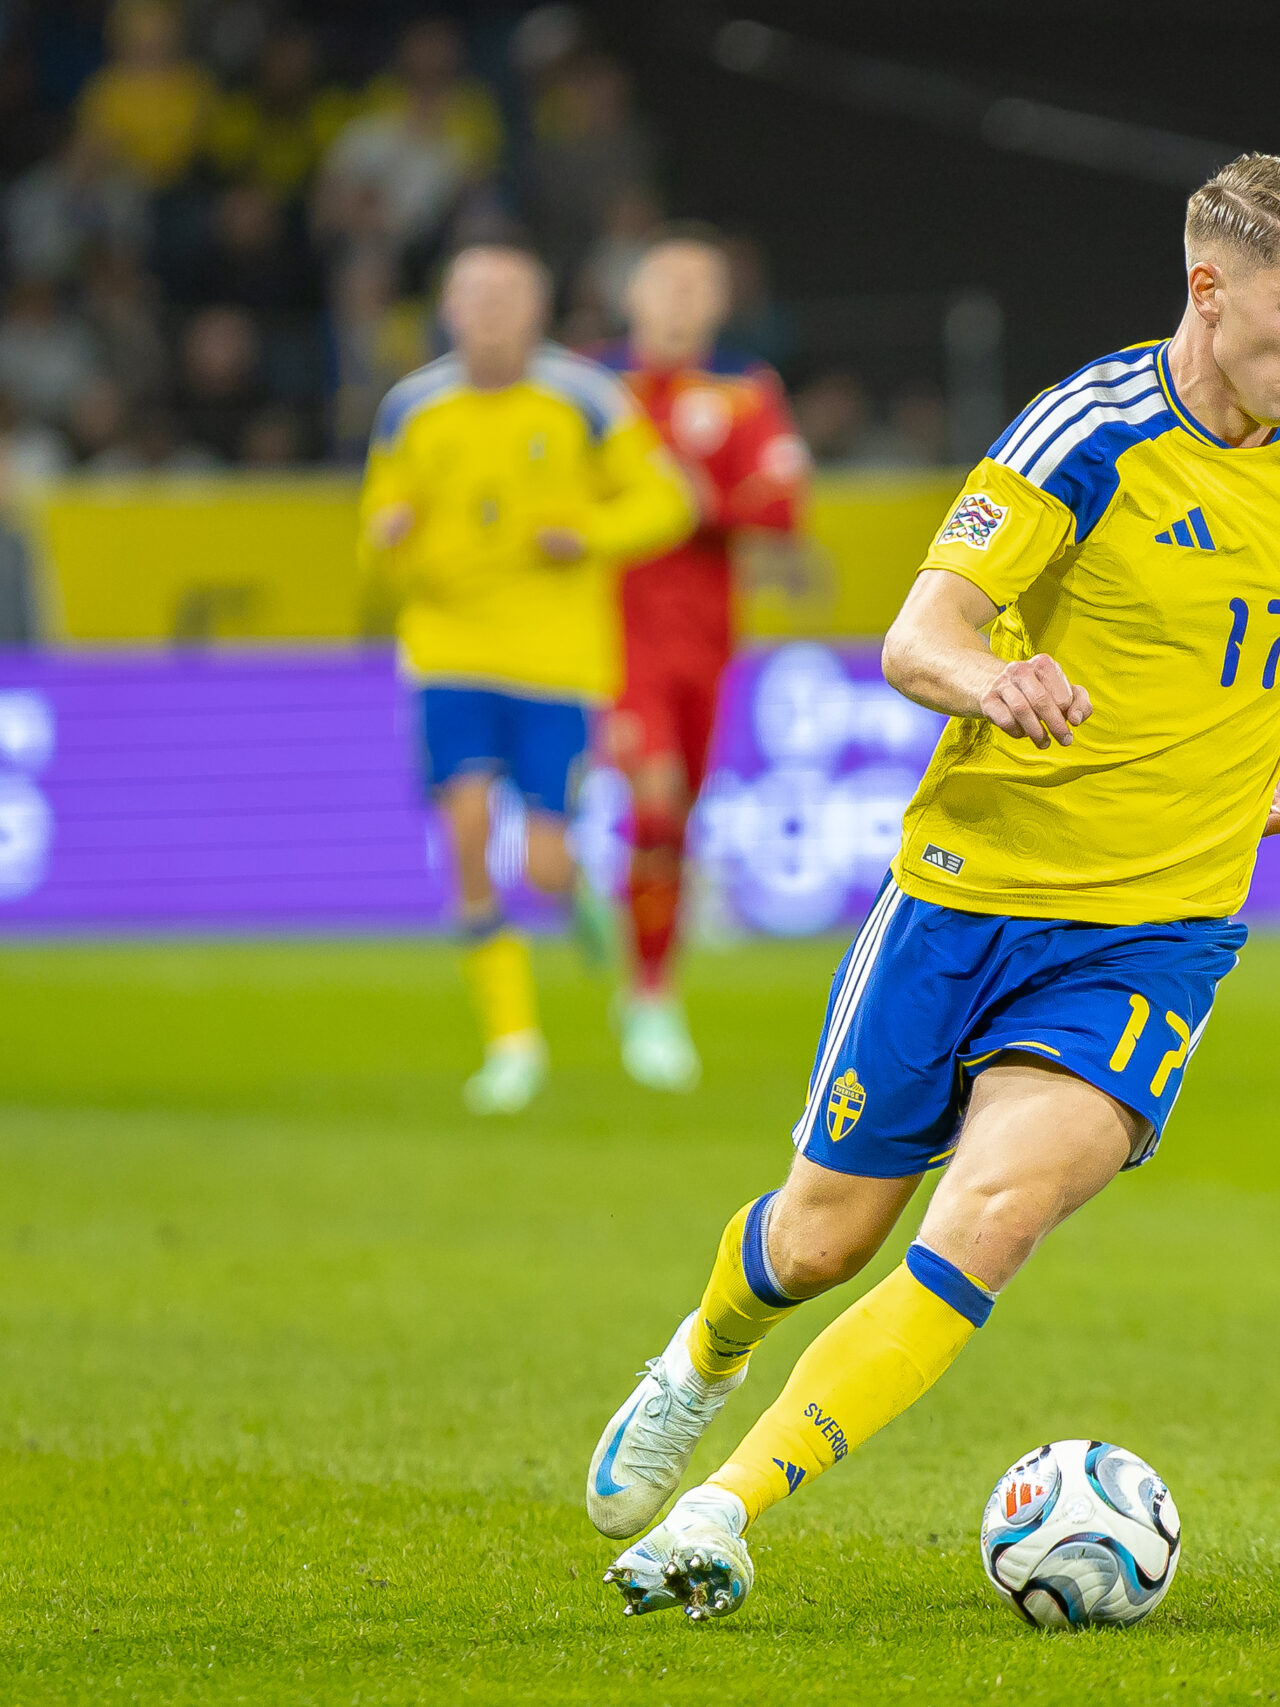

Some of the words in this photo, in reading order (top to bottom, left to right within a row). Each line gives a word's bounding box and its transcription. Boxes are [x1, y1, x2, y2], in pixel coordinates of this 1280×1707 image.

[1109, 994, 1190, 1097] 17
[835, 1086, 860, 1099] SVERIGE
[804, 1402, 848, 1463] SVERIG
